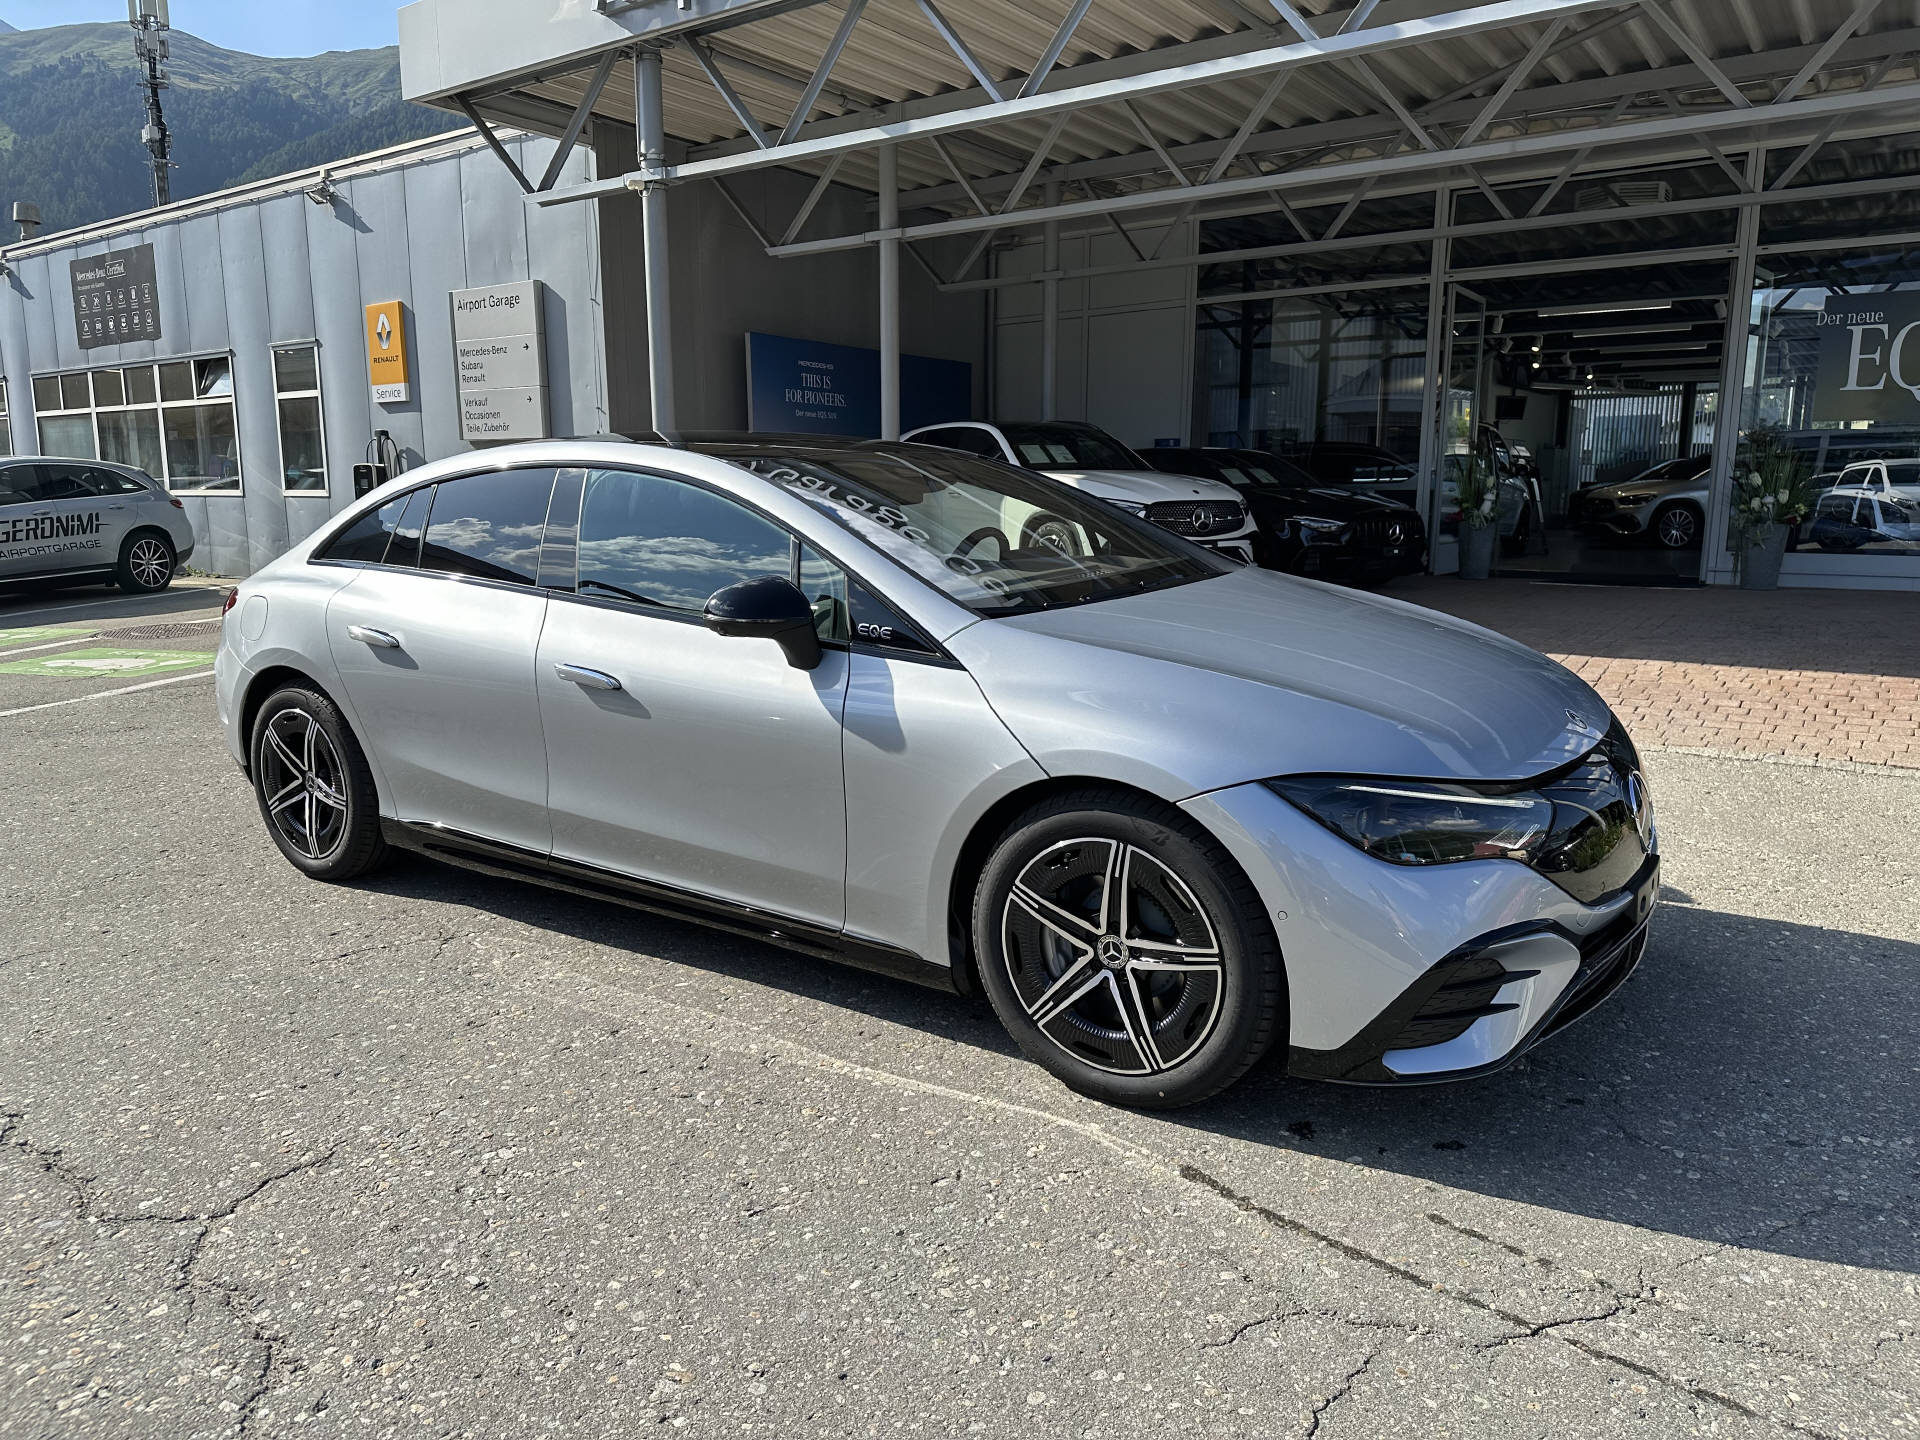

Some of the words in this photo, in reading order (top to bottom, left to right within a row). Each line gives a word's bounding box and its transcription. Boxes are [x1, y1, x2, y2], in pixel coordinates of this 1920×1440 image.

[457, 298, 487, 313] Airport
[488, 293, 521, 309] Garage
[1816, 311, 1844, 326] Der
[1847, 311, 1884, 324] neue
[459, 345, 508, 358] Mercedes-Benz
[373, 355, 399, 364] RENAULT
[461, 361, 484, 371] Subaru
[461, 374, 486, 383] Renault
[801, 373, 822, 388] THIS
[823, 375, 832, 389] IS
[376, 388, 401, 399] Service
[785, 388, 803, 403] FOR
[804, 390, 848, 407] PIONEERS.
[464, 397, 488, 408] Verkauf
[465, 411, 501, 421] Occasionen
[466, 422, 510, 433] Teile/Zubehör
[0, 540, 102, 559] AIRPORTGARAGE
[858, 623, 893, 640] EQE
